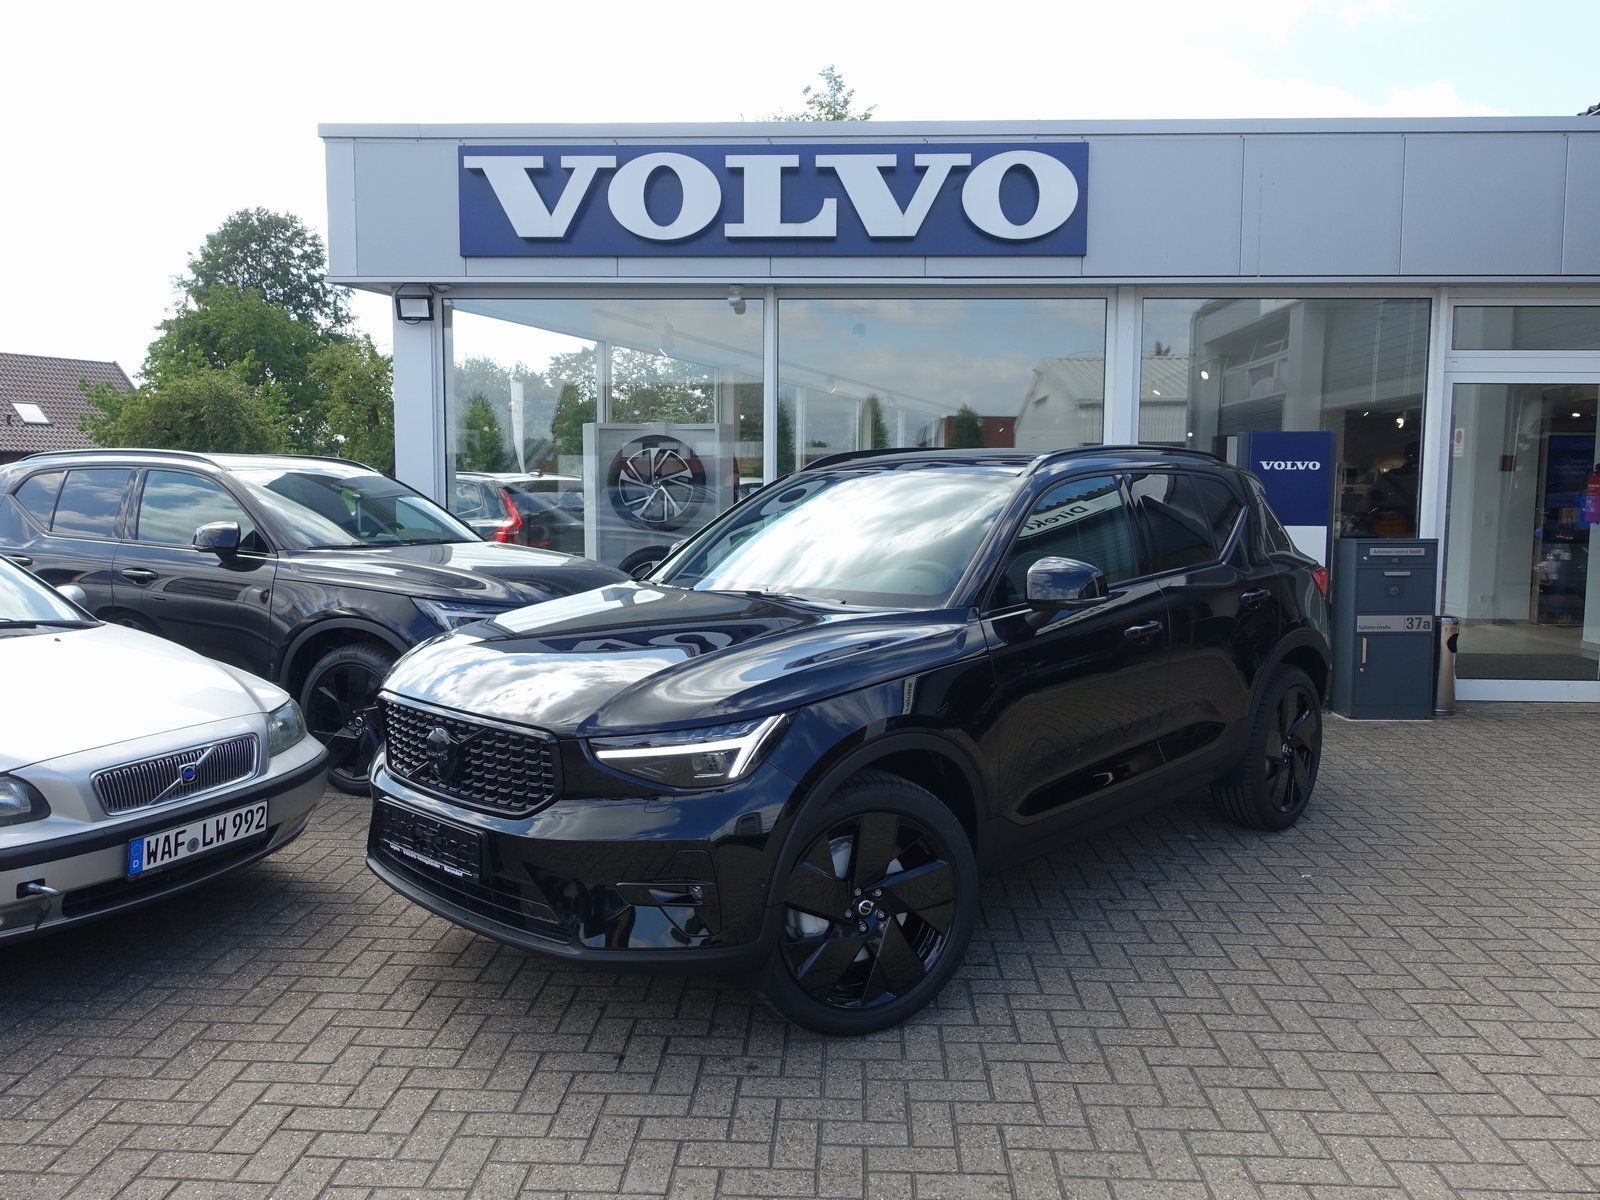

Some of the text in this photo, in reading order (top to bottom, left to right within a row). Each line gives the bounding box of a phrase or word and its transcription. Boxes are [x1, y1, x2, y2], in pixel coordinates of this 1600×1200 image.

[463, 150, 1079, 240] VOLVO
[1259, 461, 1321, 471] VOLVO
[1406, 617, 1431, 630] 37a
[146, 805, 266, 866] WAF LW 992
